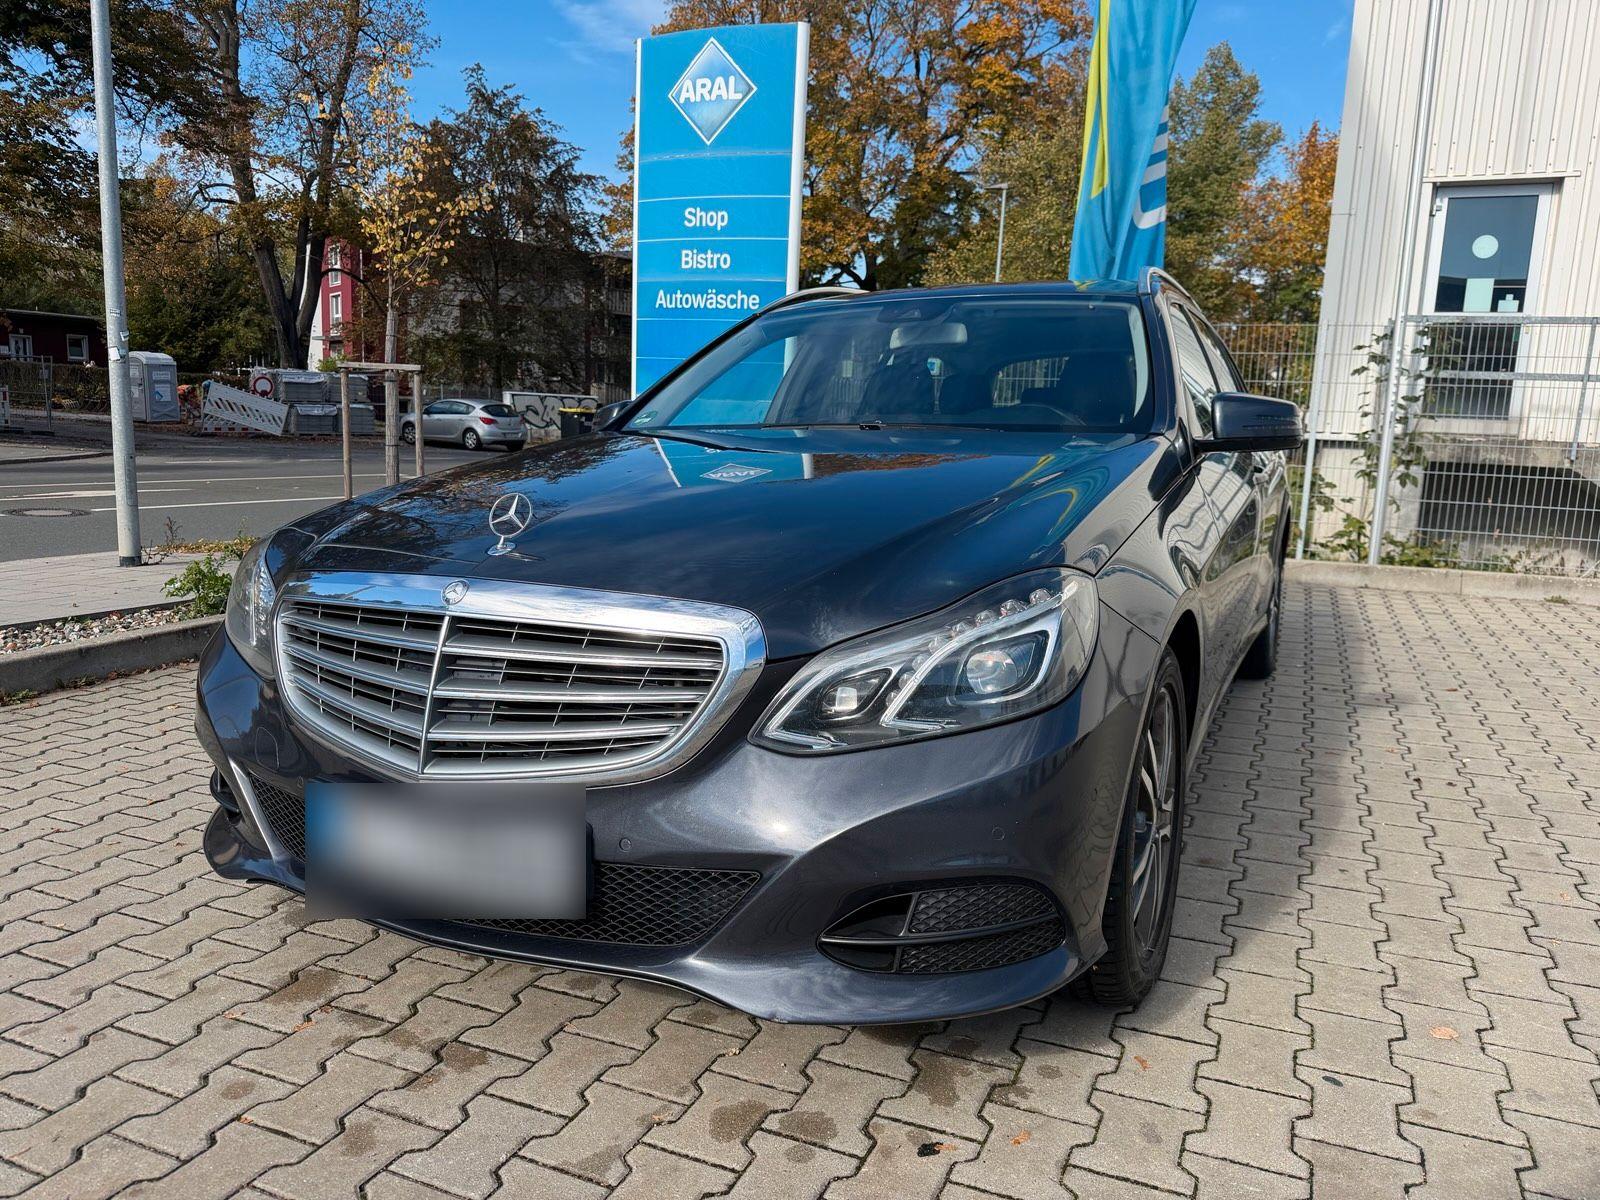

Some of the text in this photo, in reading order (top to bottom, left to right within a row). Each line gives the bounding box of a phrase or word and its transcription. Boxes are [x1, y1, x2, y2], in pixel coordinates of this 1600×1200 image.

[679, 75, 743, 104] ARAL
[684, 206, 729, 231] Shop
[681, 249, 731, 269] Bistro
[655, 288, 760, 310] Autowäsche
